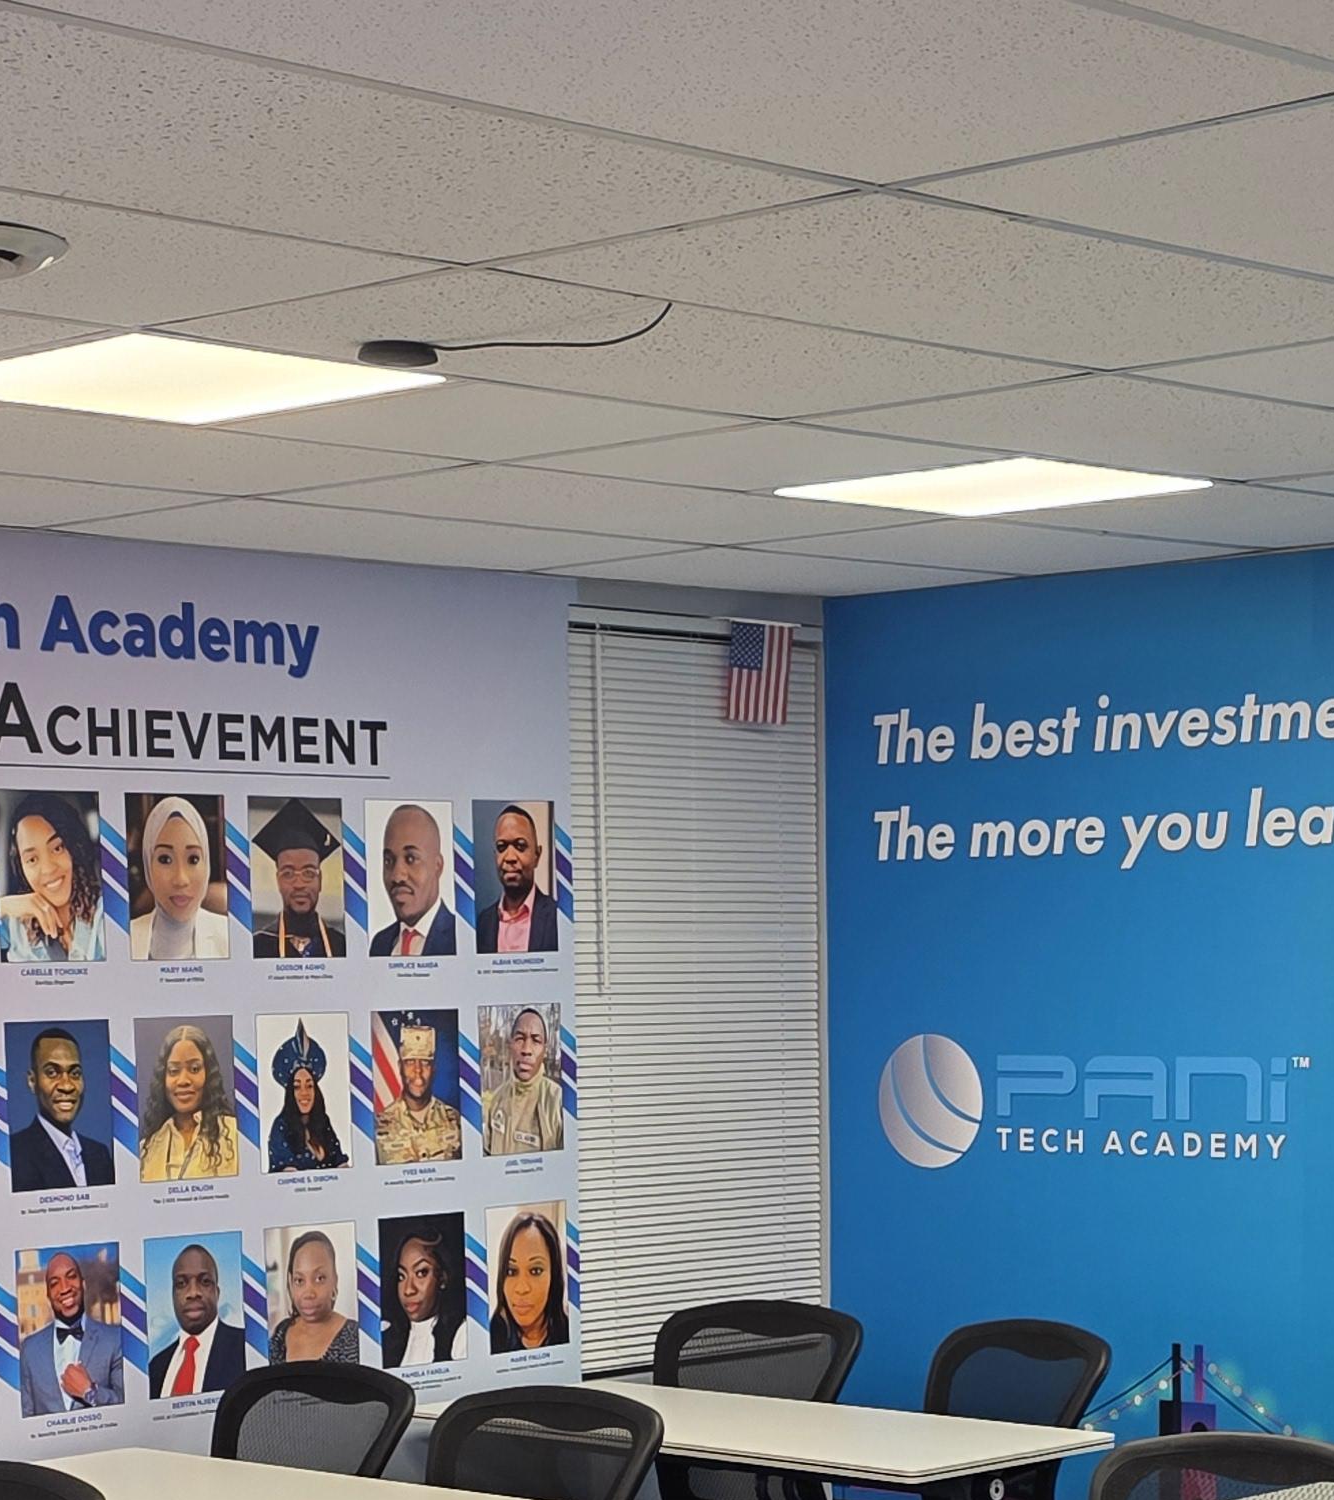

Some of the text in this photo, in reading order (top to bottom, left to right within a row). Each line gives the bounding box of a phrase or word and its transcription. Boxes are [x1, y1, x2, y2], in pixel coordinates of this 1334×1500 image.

[41, 595, 320, 679] Academy
[874, 709, 955, 764] The
[970, 702, 1081, 758] best
[874, 806, 955, 861] The
[969, 817, 1106, 859] more
[1121, 811, 1229, 870] you
[1292, 1056, 1310, 1068] TM
[996, 1127, 1286, 1159] TECH ACADEMY
[46, 1417, 76, 1428] CHARLIE
